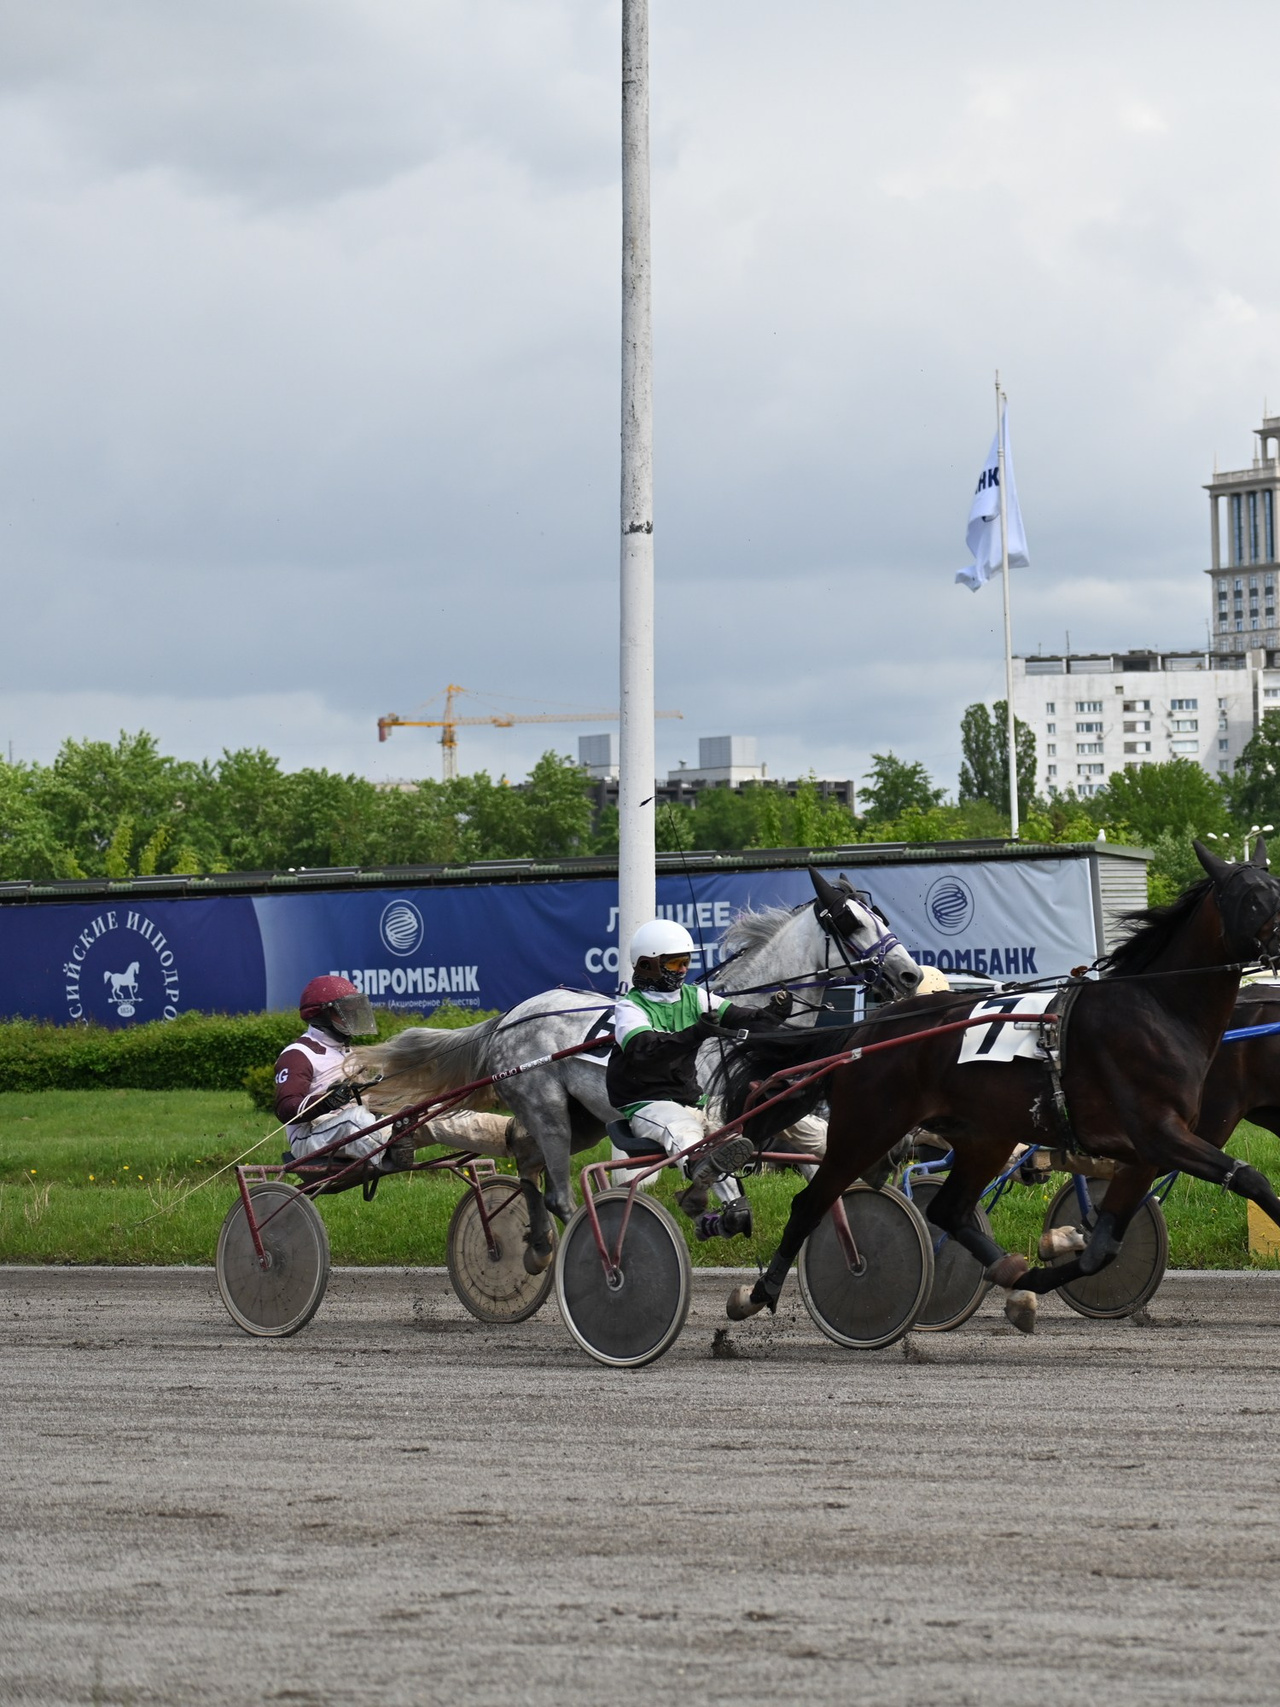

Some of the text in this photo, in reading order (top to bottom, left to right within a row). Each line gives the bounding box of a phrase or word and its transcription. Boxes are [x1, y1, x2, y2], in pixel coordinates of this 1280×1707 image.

[63, 911, 180, 1026] СИЙСКИЕ ИППОДРО
[329, 965, 480, 995] ЗПРОМБАНК
[975, 997, 1026, 1055] 7
